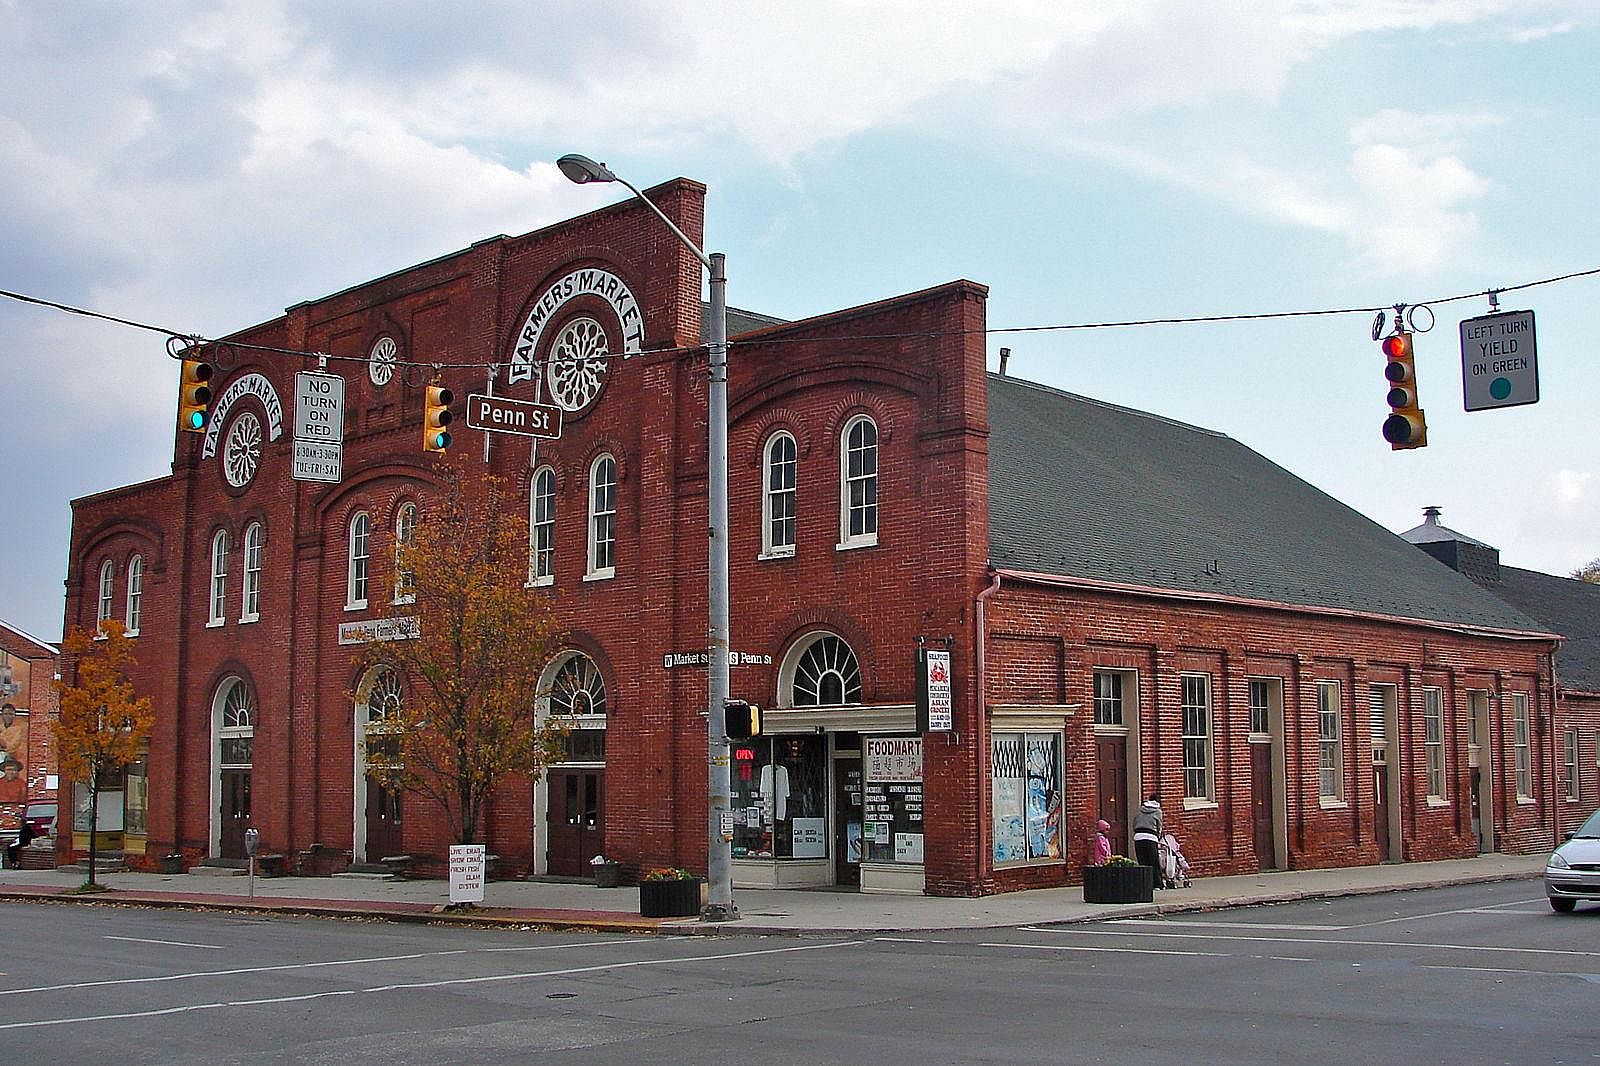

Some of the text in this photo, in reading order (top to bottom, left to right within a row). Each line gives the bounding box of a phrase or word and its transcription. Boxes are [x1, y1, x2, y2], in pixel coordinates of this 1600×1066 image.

[579, 271, 643, 343] MARKET
[1467, 320, 1528, 339] LEFT TURN
[1480, 340, 1518, 357] YIELD
[1472, 358, 1527, 375] ON GREEN
[309, 380, 331, 393] NO
[248, 378, 281, 430] MARKET
[302, 396, 337, 409] TURN
[310, 411, 329, 421] ON
[480, 402, 550, 430] Penn St
[305, 424, 331, 435] RED
[673, 653, 700, 665] Market
[741, 652, 763, 664] Penn
[764, 655, 773, 664] St
[736, 749, 754, 760] OPEN
[867, 740, 921, 756] FOODMART
